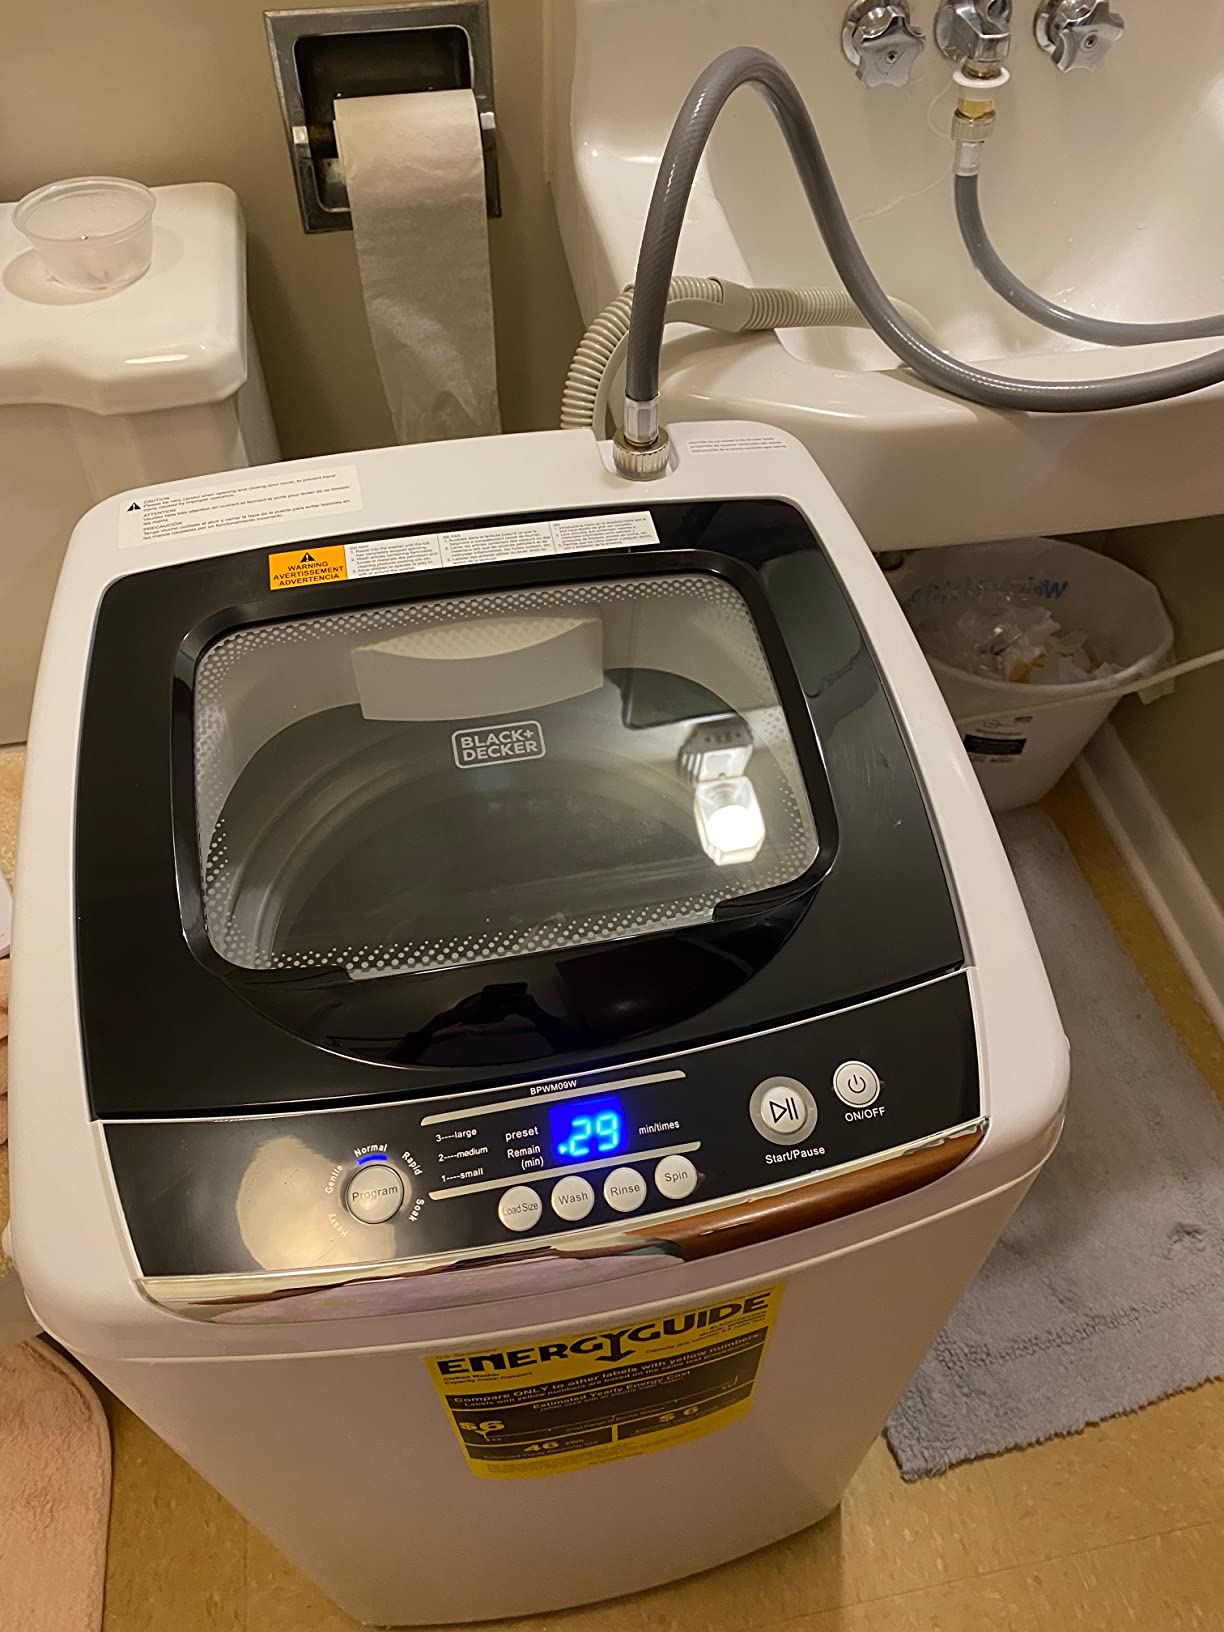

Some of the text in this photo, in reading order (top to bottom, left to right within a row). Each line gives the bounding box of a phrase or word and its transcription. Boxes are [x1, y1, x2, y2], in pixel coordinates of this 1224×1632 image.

[273, 566, 344, 580] AVERTISSEMENT
[288, 562, 328, 572] WARNING
[279, 573, 339, 586] ADVERTENCIA
[461, 729, 534, 748] BLACK+
[463, 741, 538, 761] DECKER
[530, 1080, 577, 1096] BPWM09W
[845, 1106, 885, 1122] ON/OFF
[505, 1127, 539, 1142] preset
[638, 1120, 680, 1135] min/times
[354, 1144, 388, 1158] Normal
[507, 1145, 541, 1159] Remain
[765, 1147, 826, 1164] Start/Pause
[402, 1151, 423, 1176] Rapid
[521, 1156, 544, 1170] (min)
[325, 1165, 343, 1194] Gentle
[664, 1170, 688, 1183] Spin
[352, 1186, 398, 1201] Program
[610, 1183, 640, 1197] Rinse
[558, 1191, 588, 1205] Wash
[409, 1199, 424, 1222] Soak
[437, 1292, 771, 1376] ENERGYGUIDE
[454, 1394, 510, 1403] Compare
[514, 1386, 549, 1397] ONLY
[568, 1373, 596, 1387] other
[603, 1366, 637, 1378] labels
[641, 1360, 666, 1370] with
[669, 1350, 706, 1365] yellow
[533, 1371, 691, 1409] Estimated Yearly Energy Cost
[524, 1441, 559, 1452] 46
